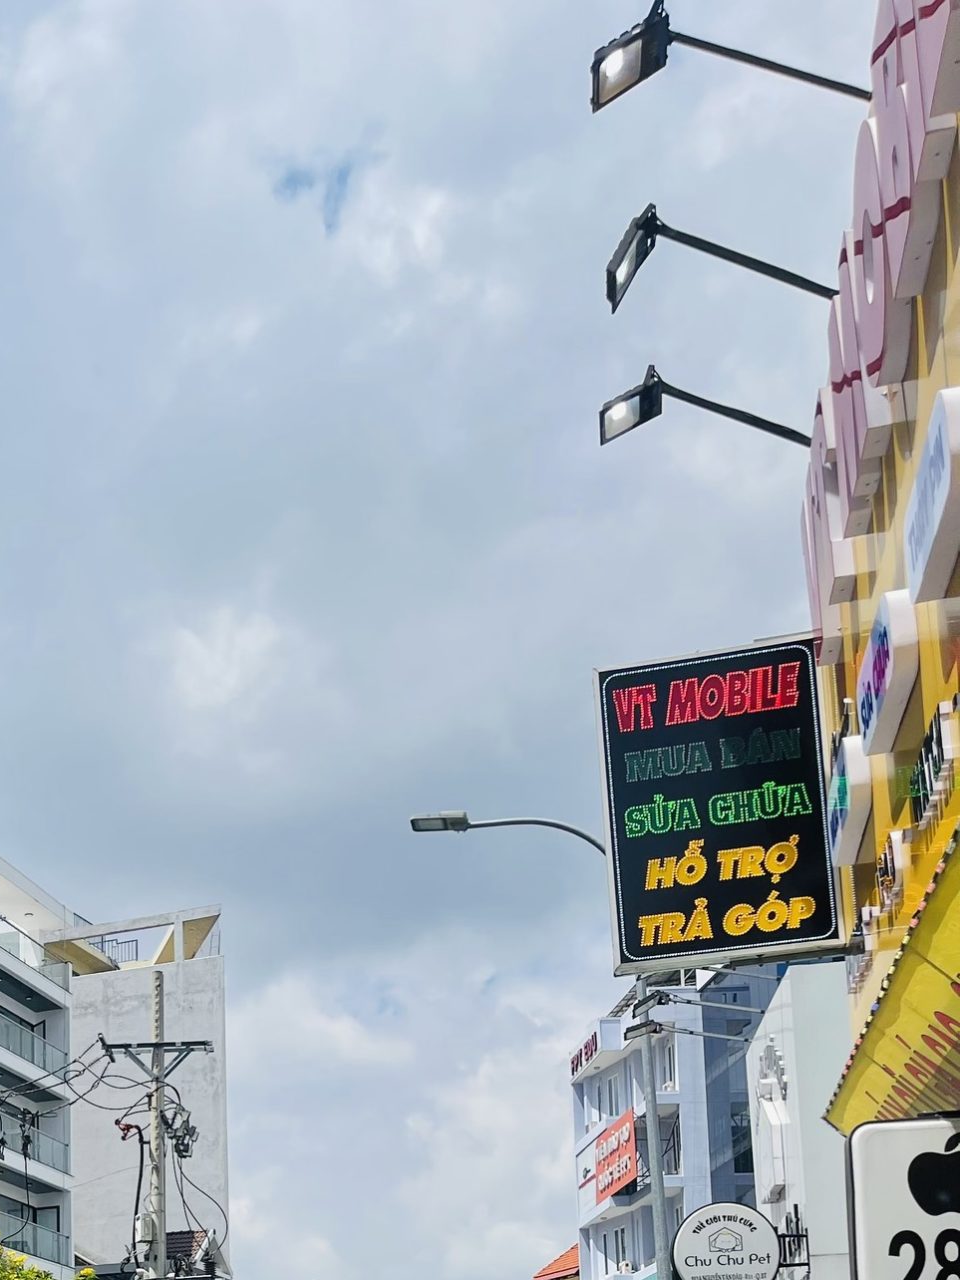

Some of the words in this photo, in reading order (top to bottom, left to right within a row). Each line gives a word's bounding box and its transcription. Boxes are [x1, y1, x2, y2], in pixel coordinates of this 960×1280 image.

[612, 683, 657, 733] VT
[665, 661, 802, 726] MOBILE
[624, 741, 713, 783] MUA
[719, 726, 802, 770] BÁN
[624, 793, 702, 838] SỬA
[708, 780, 813, 826] CHỮA
[644, 839, 708, 890] HỖ
[716, 834, 801, 884] TRỢ
[637, 897, 715, 947] TRẢ
[722, 889, 817, 937] GÓP
[684, 1255, 712, 1267] Chu
[716, 1254, 745, 1266] Chu
[748, 1253, 771, 1265] Pet
